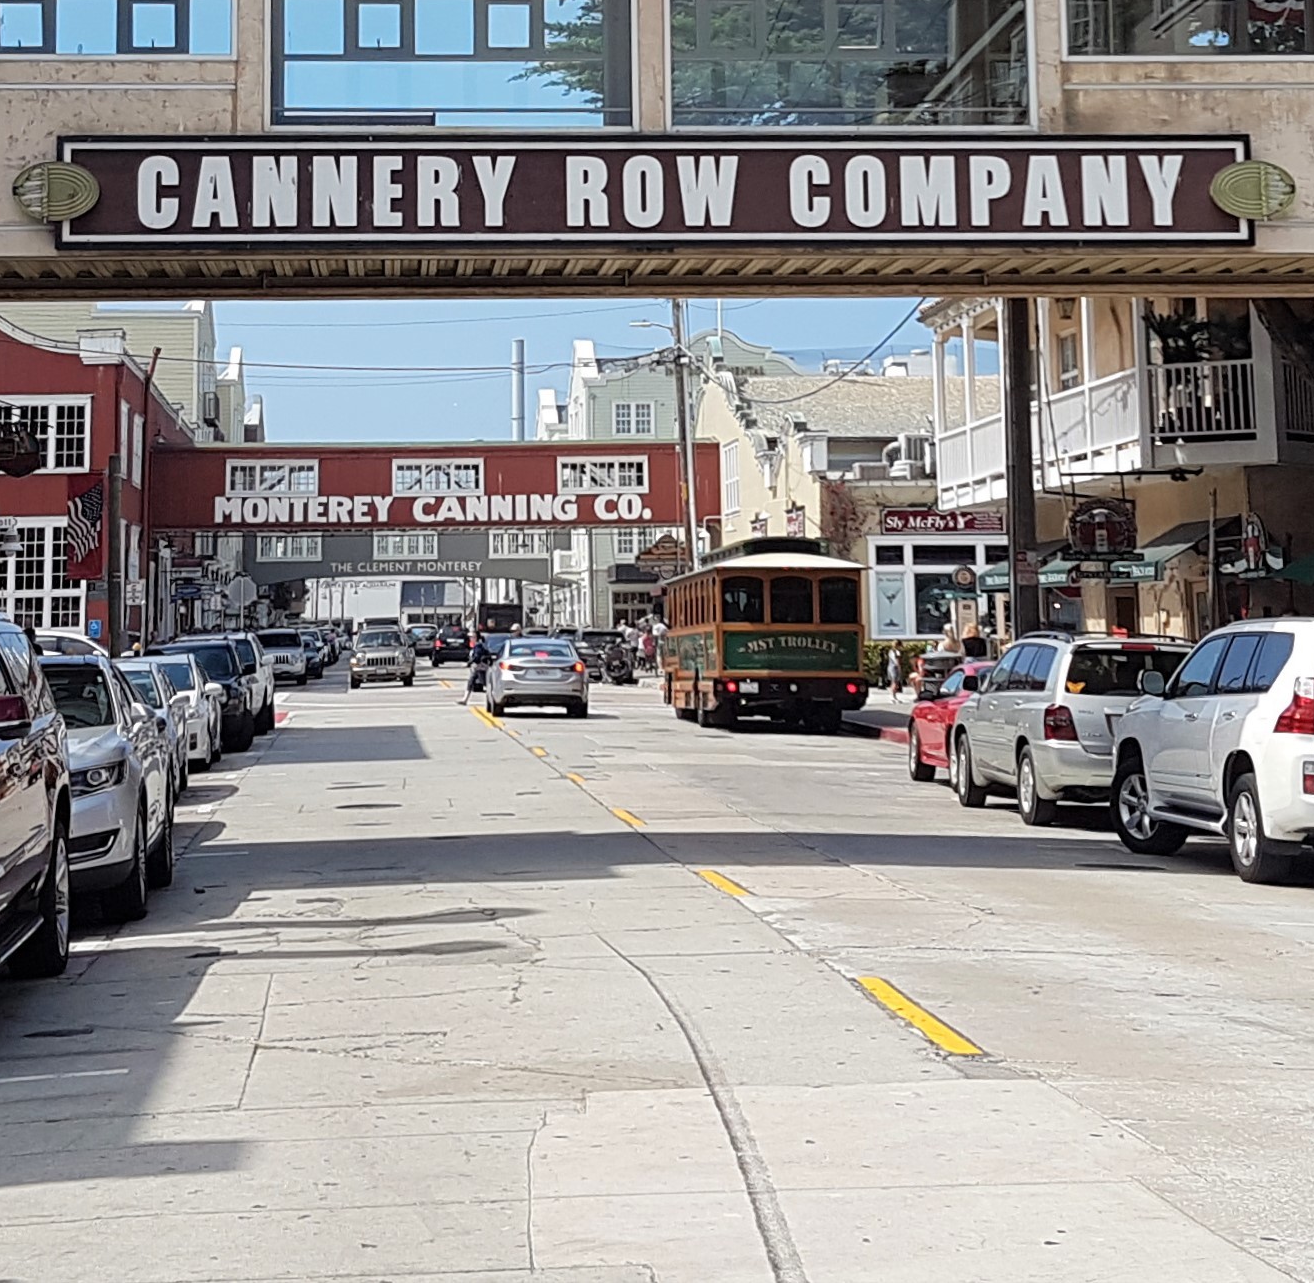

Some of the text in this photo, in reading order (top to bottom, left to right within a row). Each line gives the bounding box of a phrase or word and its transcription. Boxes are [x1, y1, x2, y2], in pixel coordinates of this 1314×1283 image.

[136, 154, 1184, 228] CANNERY ROW COMPANY
[214, 493, 652, 524] MONTEREY CANNING CO.
[885, 516, 904, 530] Sly
[330, 561, 483, 572] THE CLEMENT MONTEREY
[747, 636, 839, 654] MST TROLLEY
